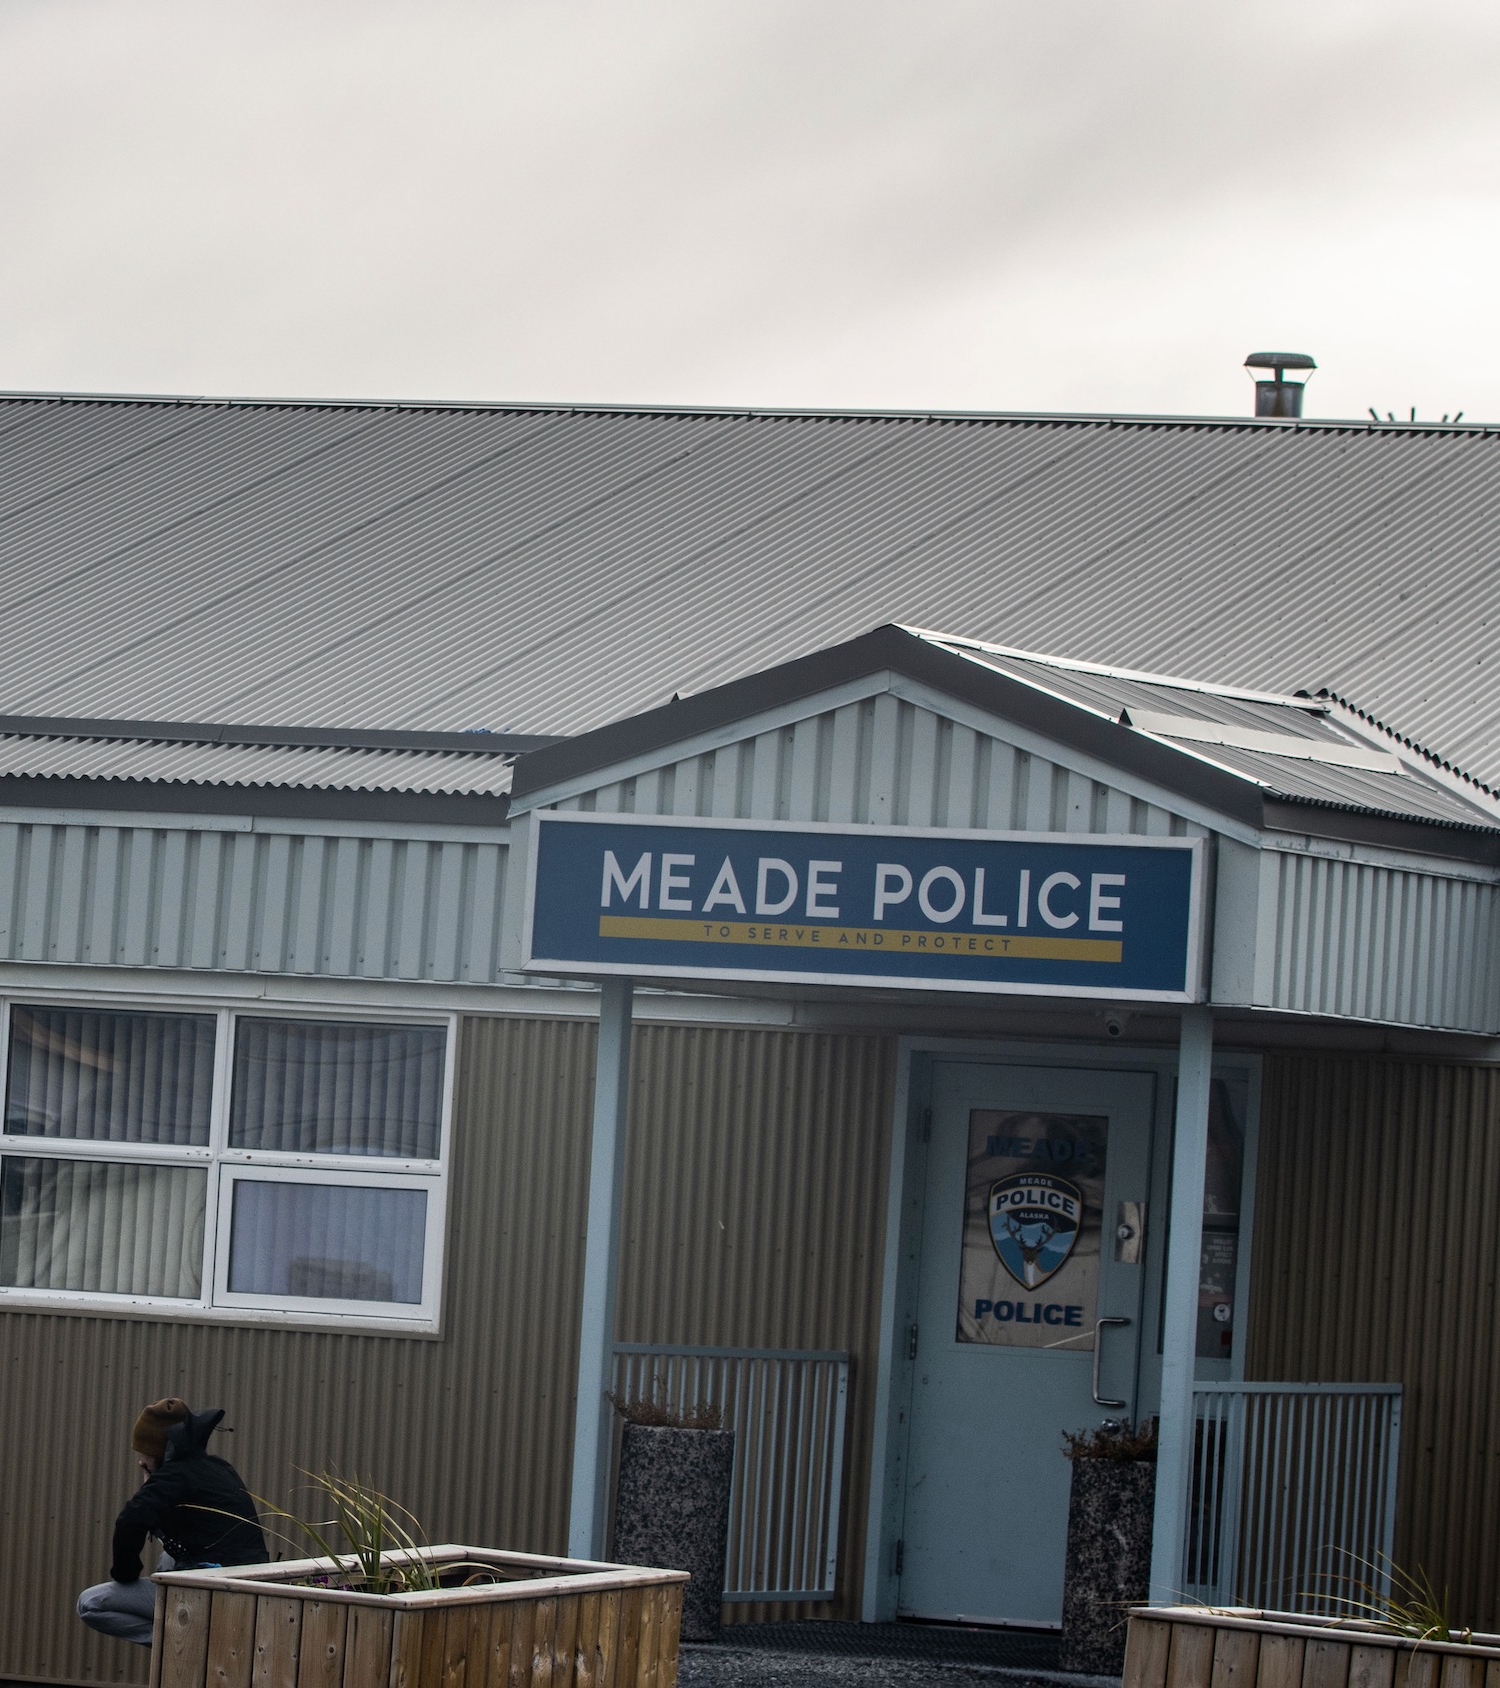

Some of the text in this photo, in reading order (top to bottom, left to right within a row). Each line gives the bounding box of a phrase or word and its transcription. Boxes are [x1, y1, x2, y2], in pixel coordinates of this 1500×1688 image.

[600, 850, 1126, 932] MEADE POLICE
[703, 924, 1011, 952] TO SERVE AND PROTECT
[1019, 1177, 1053, 1187] MEADE
[996, 1189, 1074, 1216] POLICE
[1019, 1212, 1050, 1220] ALASKA
[974, 1299, 1083, 1327] POLICE
